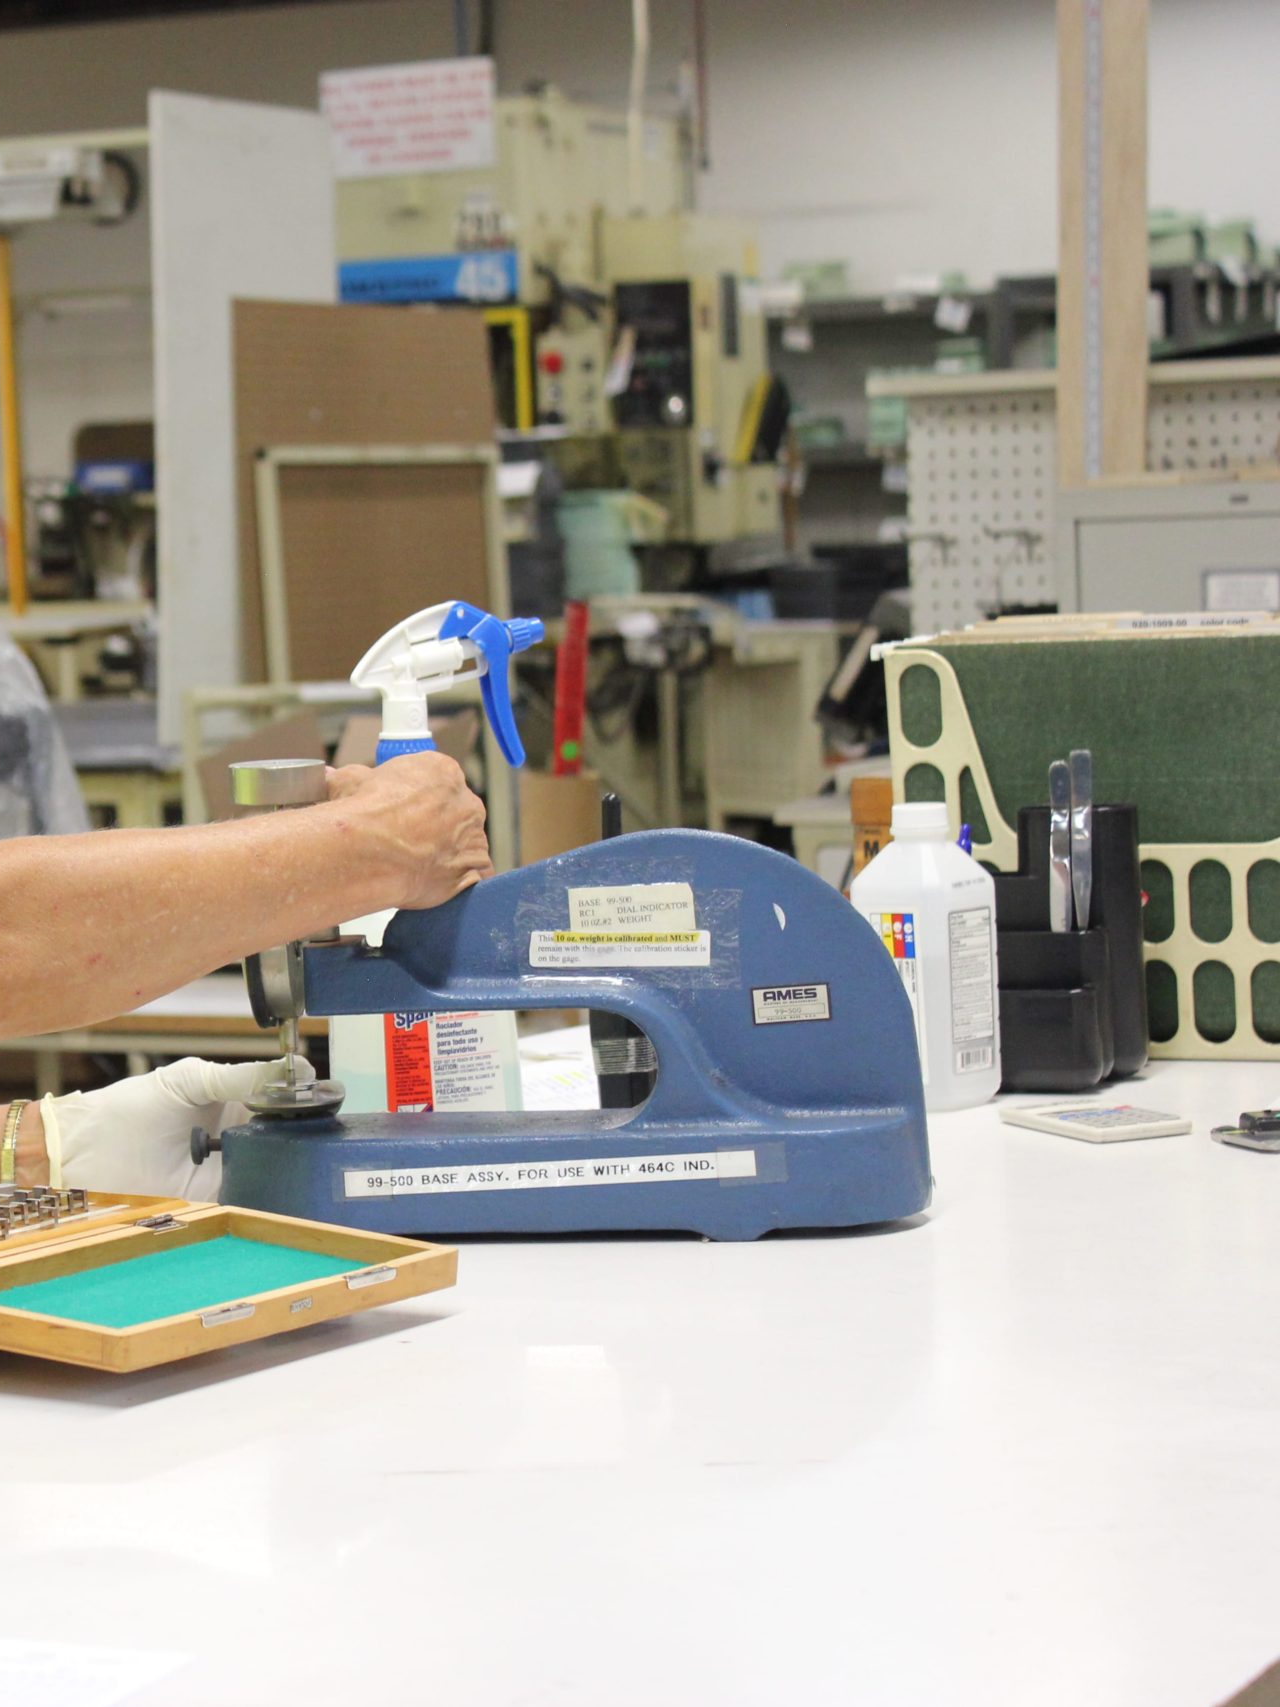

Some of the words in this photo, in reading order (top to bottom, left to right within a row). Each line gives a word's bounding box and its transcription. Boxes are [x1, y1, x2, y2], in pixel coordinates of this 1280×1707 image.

[578, 899, 601, 908] BASE
[617, 906, 639, 915] DIAL
[640, 901, 689, 913] INDICATOR
[618, 915, 653, 925] WEIGHT
[539, 934, 554, 942] This
[556, 934, 565, 942] 10
[579, 934, 605, 944] weight
[606, 934, 613, 942] is
[614, 934, 653, 943] calibrated
[654, 934, 668, 942] and
[669, 934, 695, 942] MUST
[537, 945, 562, 953] remain
[564, 944, 580, 952] with
[582, 944, 595, 952] this
[634, 944, 670, 953] calibration
[673, 943, 698, 953] sticker
[700, 943, 707, 952] is
[548, 954, 560, 962] the
[763, 987, 818, 1002] AMES
[435, 1021, 463, 1030] Rociador
[436, 1028, 478, 1039] desinfectante
[436, 1039, 451, 1048] para
[437, 1046, 477, 1056] limpiavidrios
[366, 1175, 414, 1189] 99-500
[421, 1173, 459, 1186] BASE
[467, 1171, 510, 1183] ASSY.
[518, 1168, 549, 1180] FOR
[557, 1166, 585, 1179] USE
[593, 1164, 631, 1177] WITH
[638, 1161, 676, 1174] 464C
[683, 1159, 715, 1172] IND.
